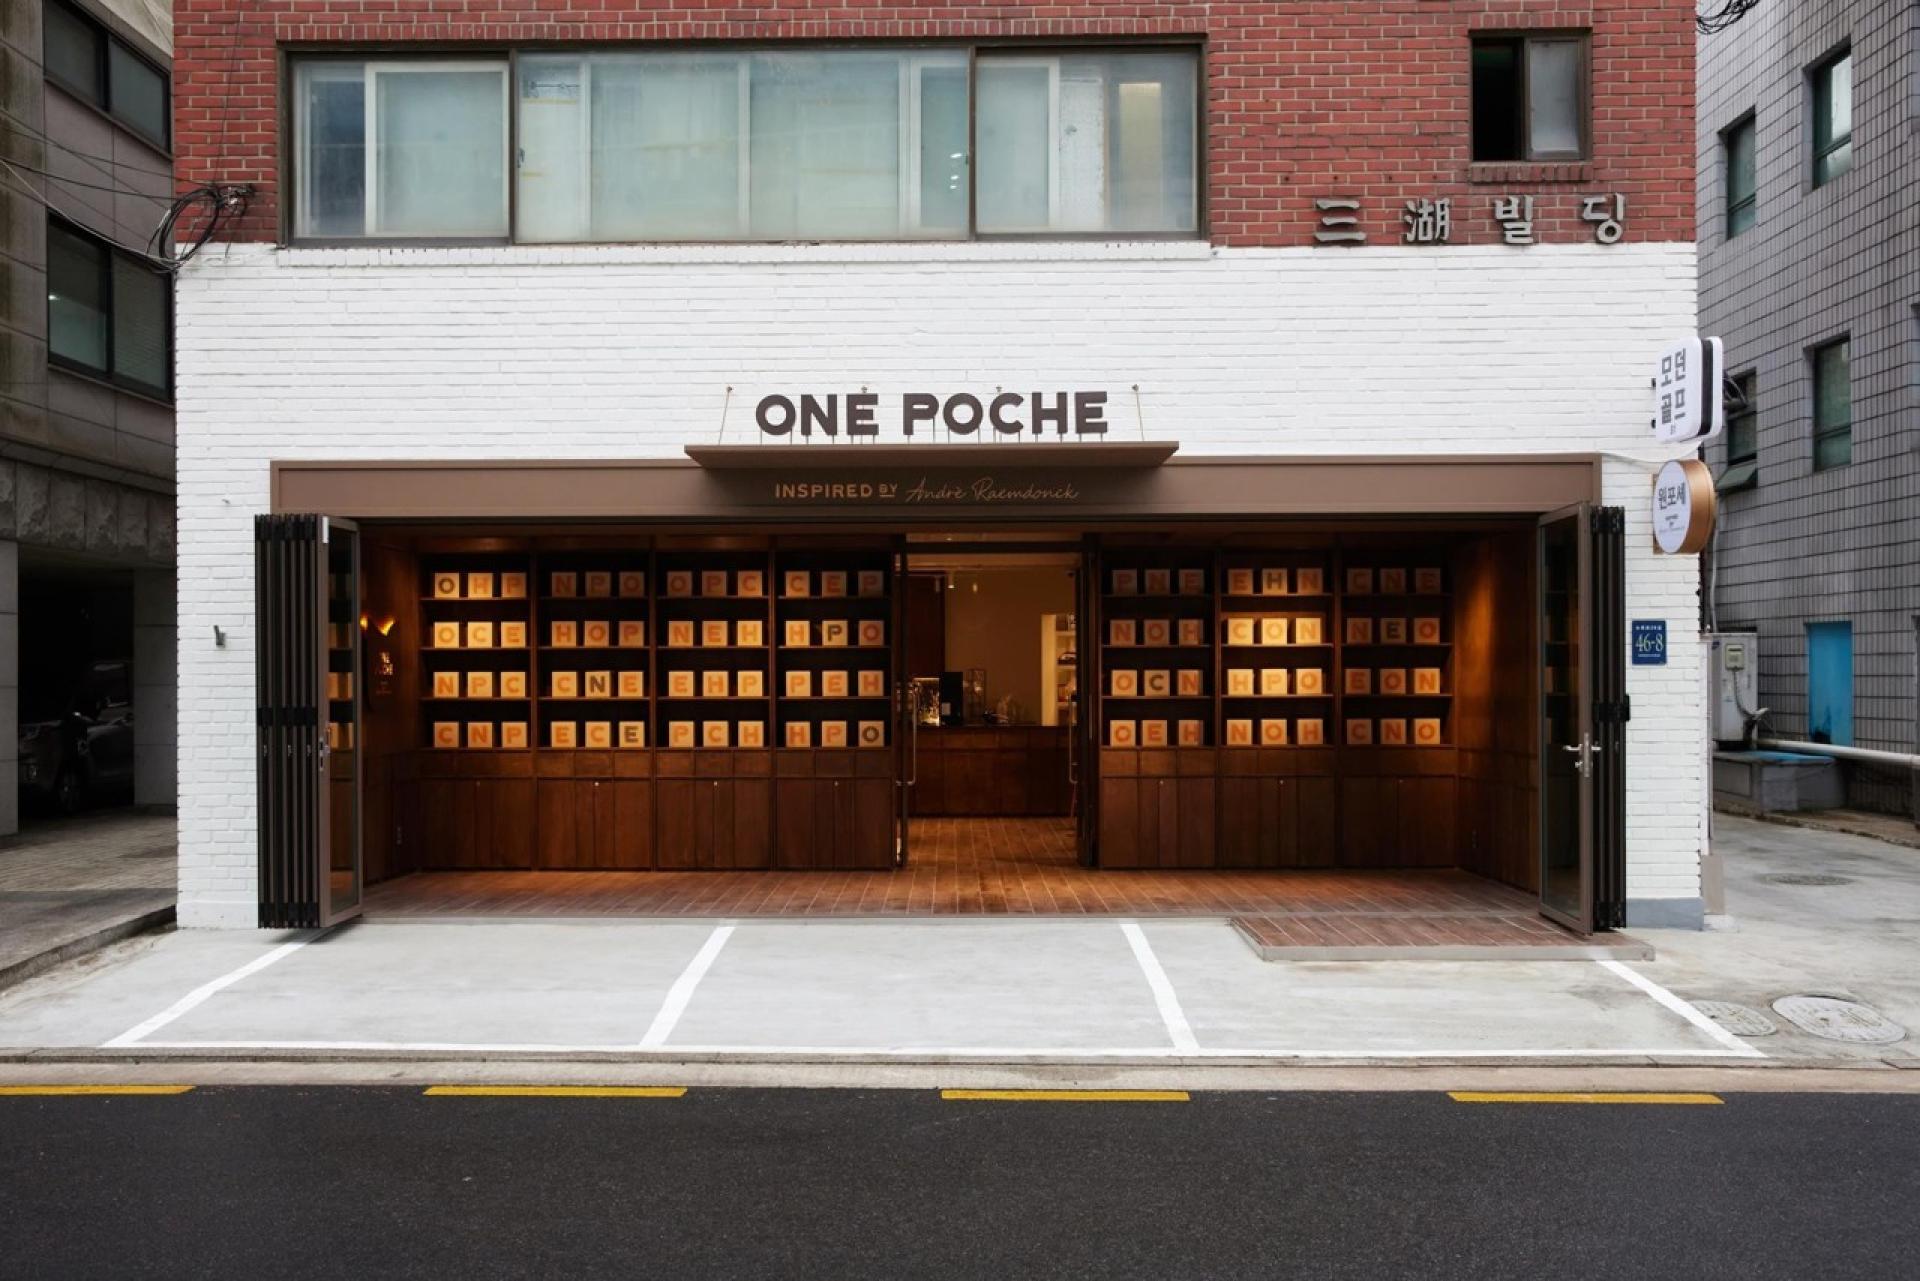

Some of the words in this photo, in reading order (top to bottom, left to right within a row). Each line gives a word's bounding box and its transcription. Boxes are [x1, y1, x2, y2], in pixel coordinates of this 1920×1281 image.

[755, 393, 880, 436] ONE
[903, 391, 1108, 436] POCHE
[775, 483, 873, 499] INSPIRED
[879, 483, 898, 498] BY
[971, 478, 1080, 502] Raemdonck
[1635, 633, 1664, 652] 46-8
